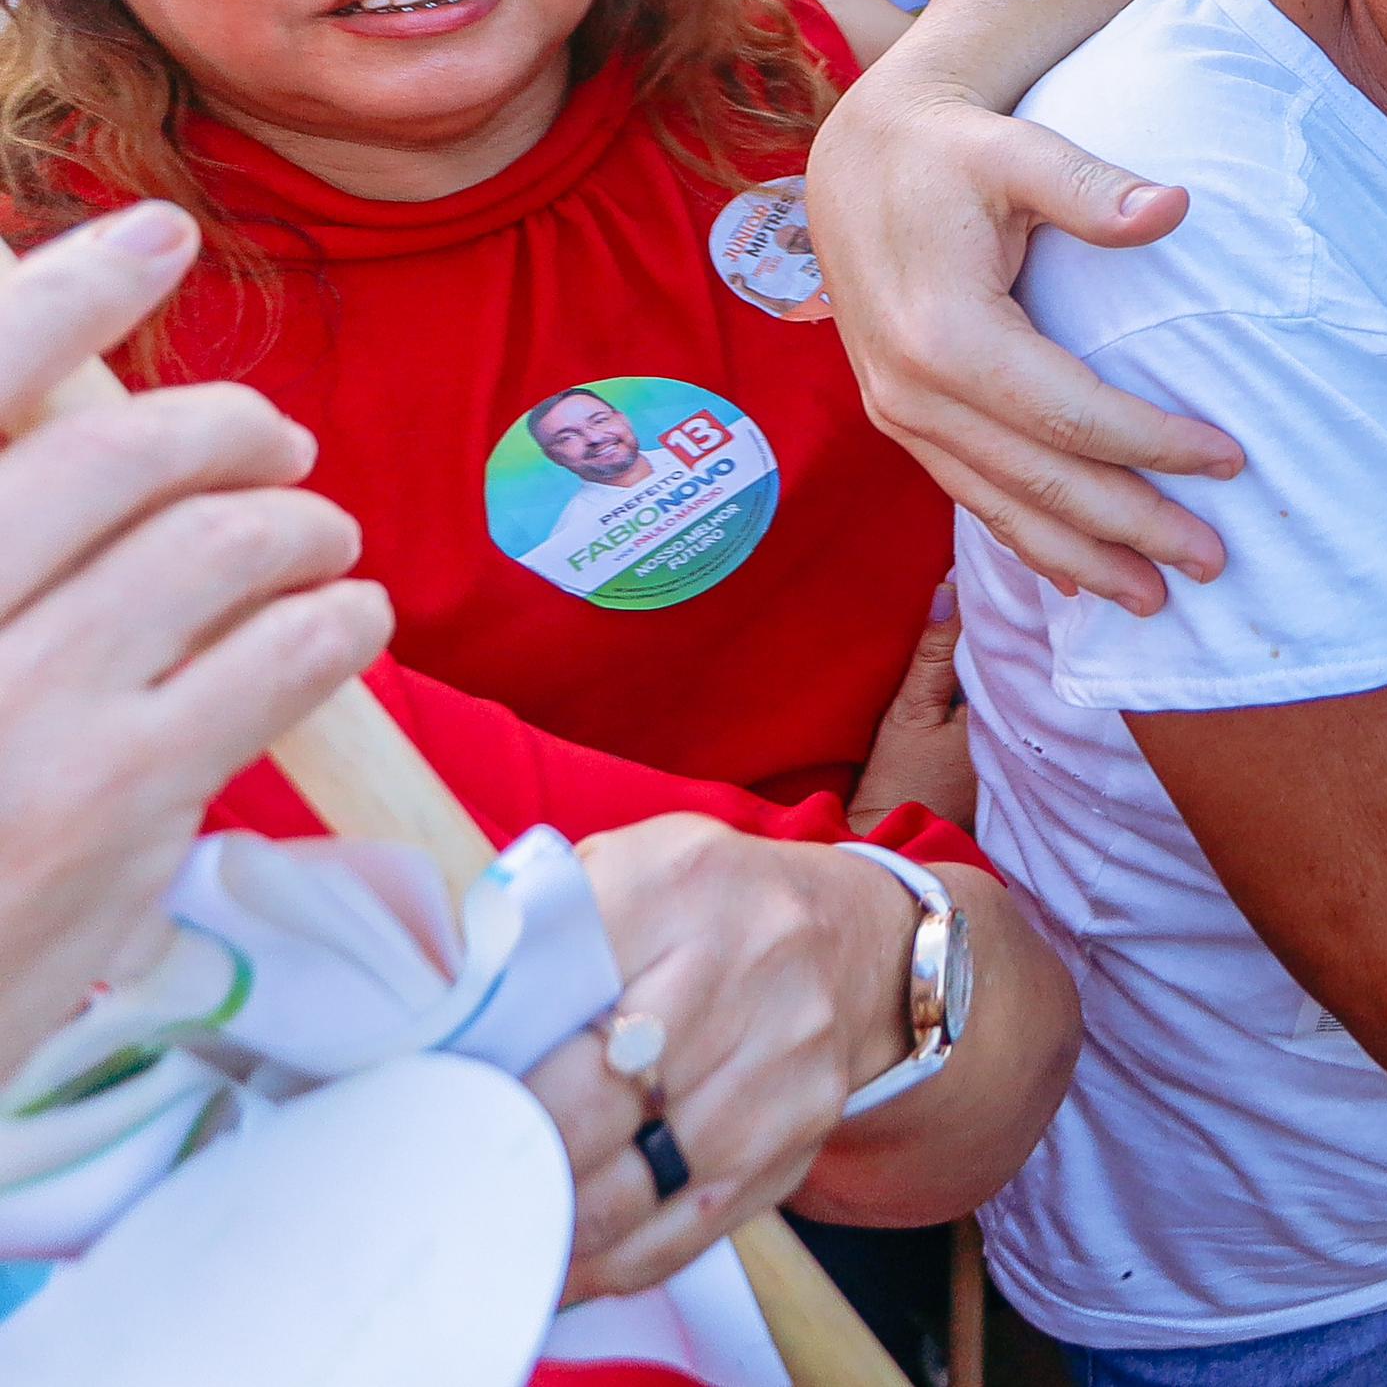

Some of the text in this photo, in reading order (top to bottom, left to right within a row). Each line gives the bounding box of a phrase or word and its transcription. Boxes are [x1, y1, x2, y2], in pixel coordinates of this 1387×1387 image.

[667, 417, 725, 459] 13
[601, 470, 685, 526] PREFEITO
[634, 539, 685, 578] NOSSO
